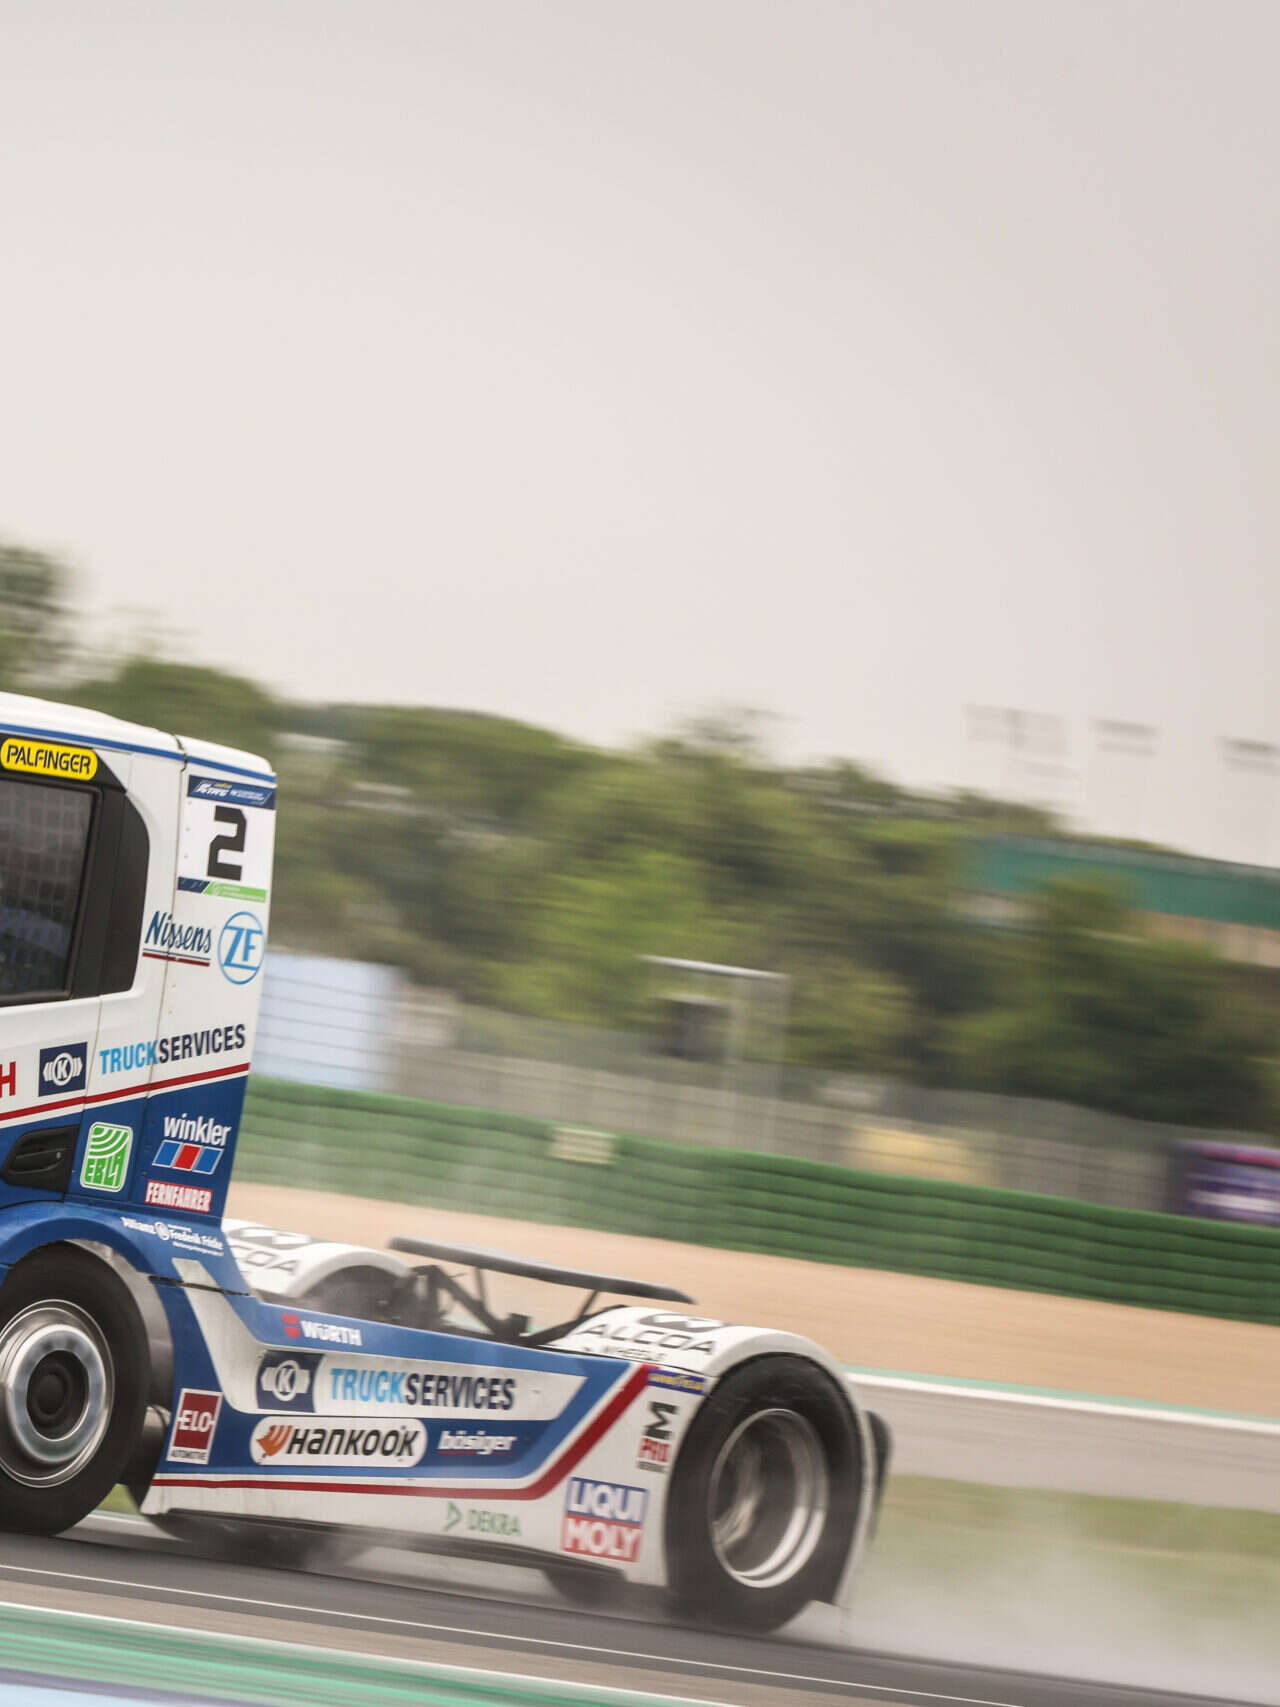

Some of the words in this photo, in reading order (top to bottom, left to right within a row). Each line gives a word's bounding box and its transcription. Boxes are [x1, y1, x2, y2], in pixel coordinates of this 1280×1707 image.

[6, 745, 91, 774] PALFINGER
[207, 805, 247, 881] 2
[145, 910, 212, 953] Nissens
[164, 1113, 232, 1146] winkler
[576, 1324, 716, 1355] ALCOA
[572, 1479, 646, 1523] LIQUI
[566, 1517, 641, 1560] MOLY
